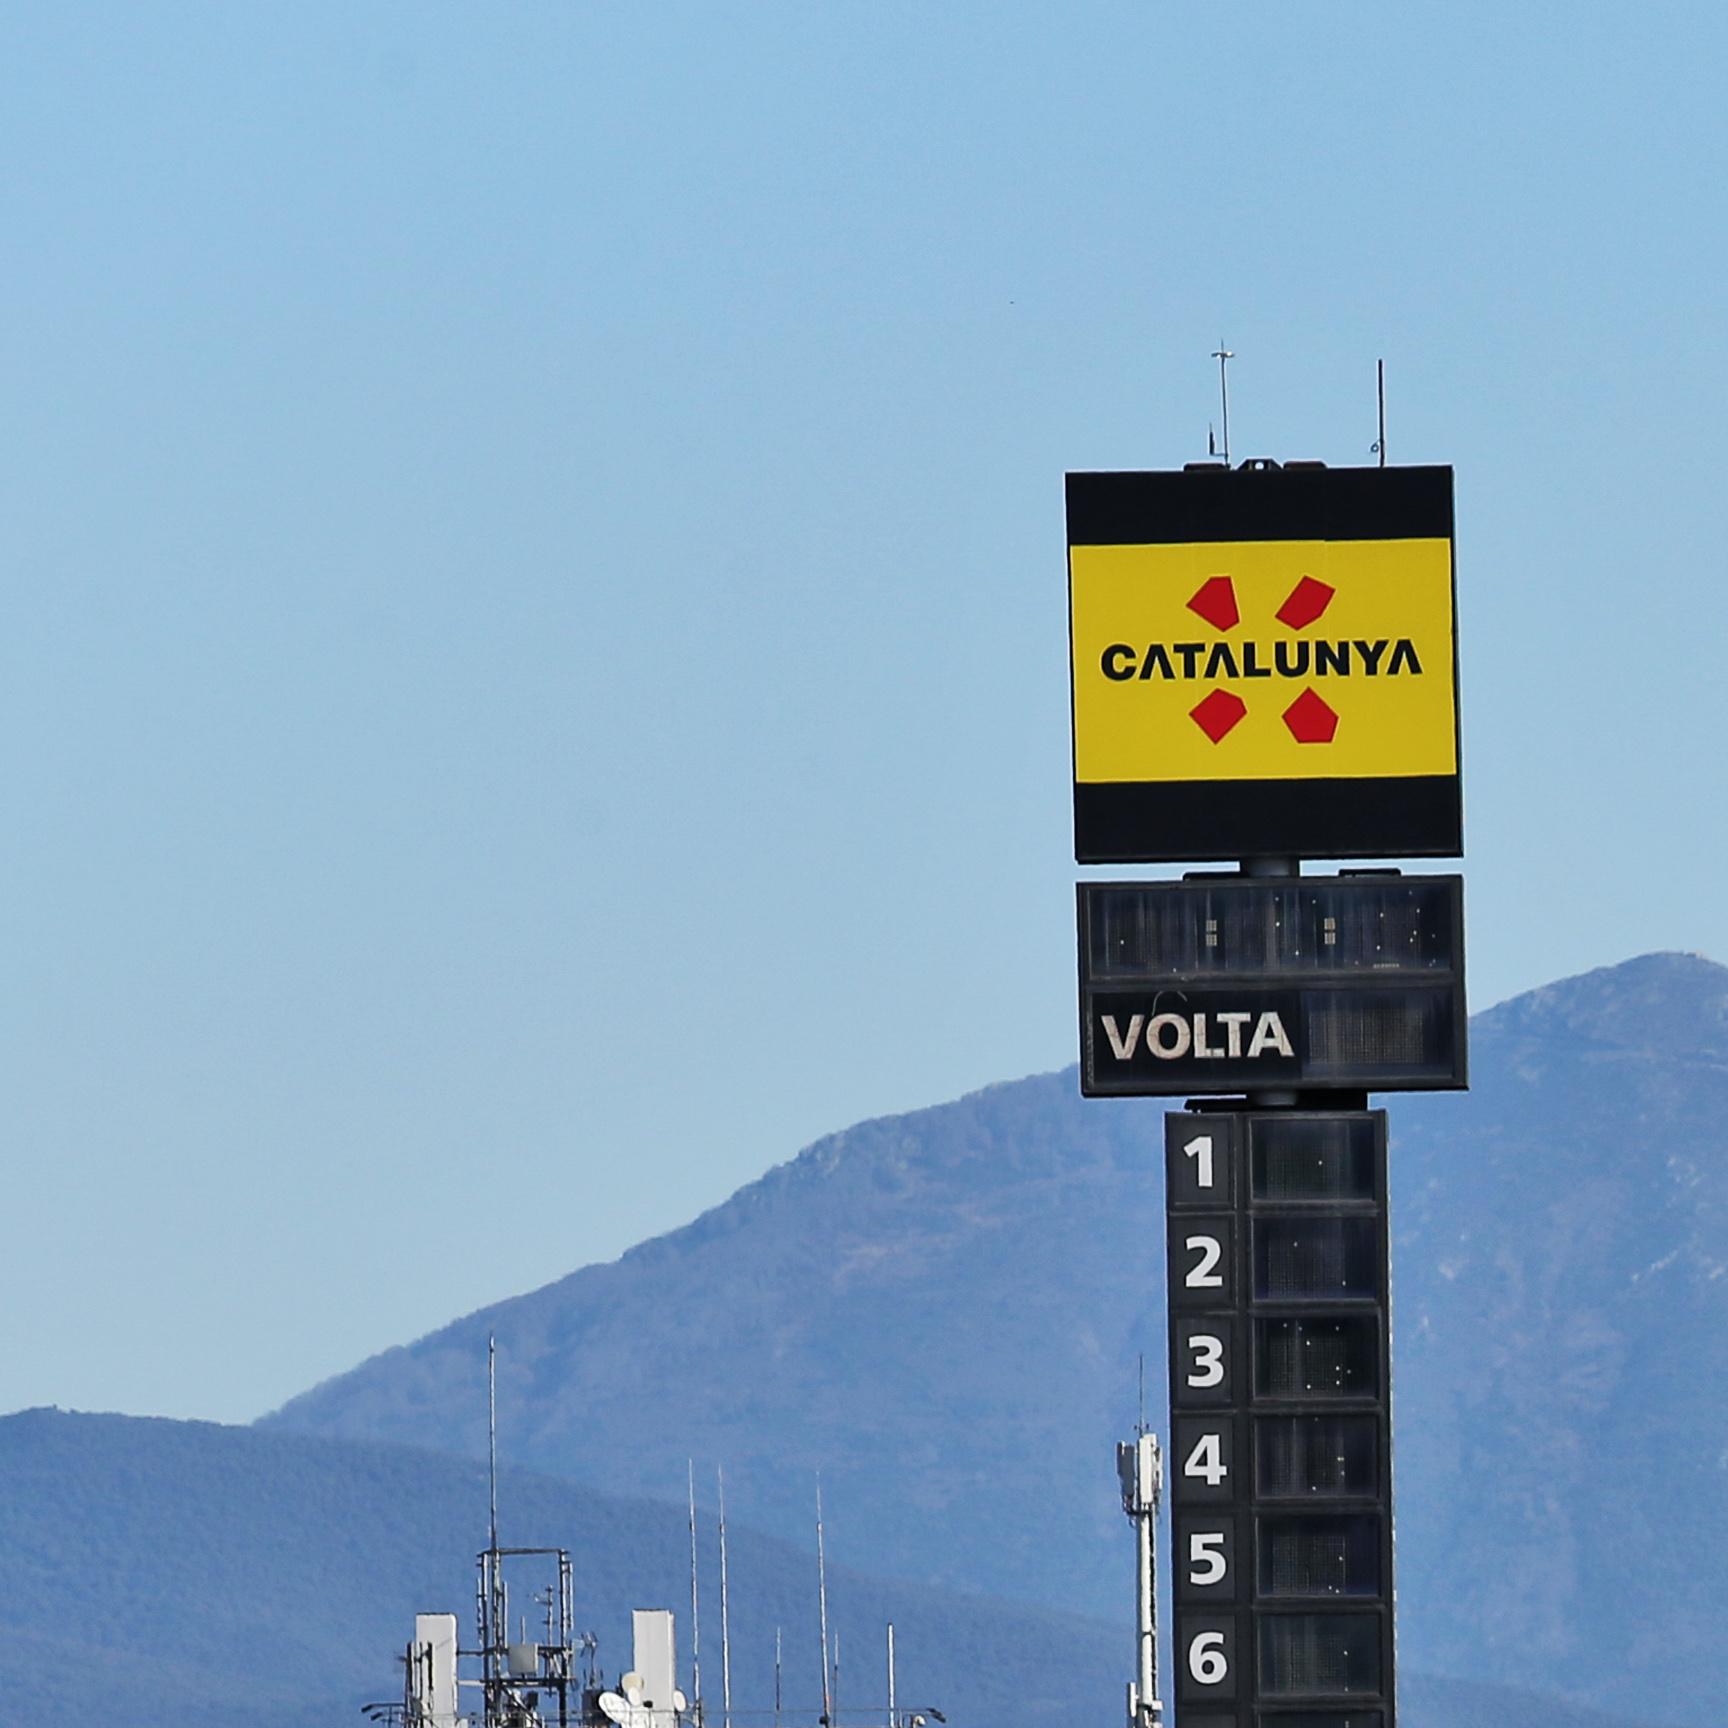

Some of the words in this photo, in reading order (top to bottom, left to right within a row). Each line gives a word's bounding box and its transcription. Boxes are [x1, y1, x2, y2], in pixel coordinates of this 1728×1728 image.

[1100, 639, 1422, 681] CATALUNYA
[1100, 1011, 1295, 1060] VOLTA
[1183, 1135, 1214, 1188] 1
[1185, 1235, 1223, 1288] 2
[1186, 1335, 1224, 1387] 3
[1184, 1434, 1227, 1486] 4
[1189, 1532, 1227, 1585] 5
[1188, 1631, 1227, 1684] 6
